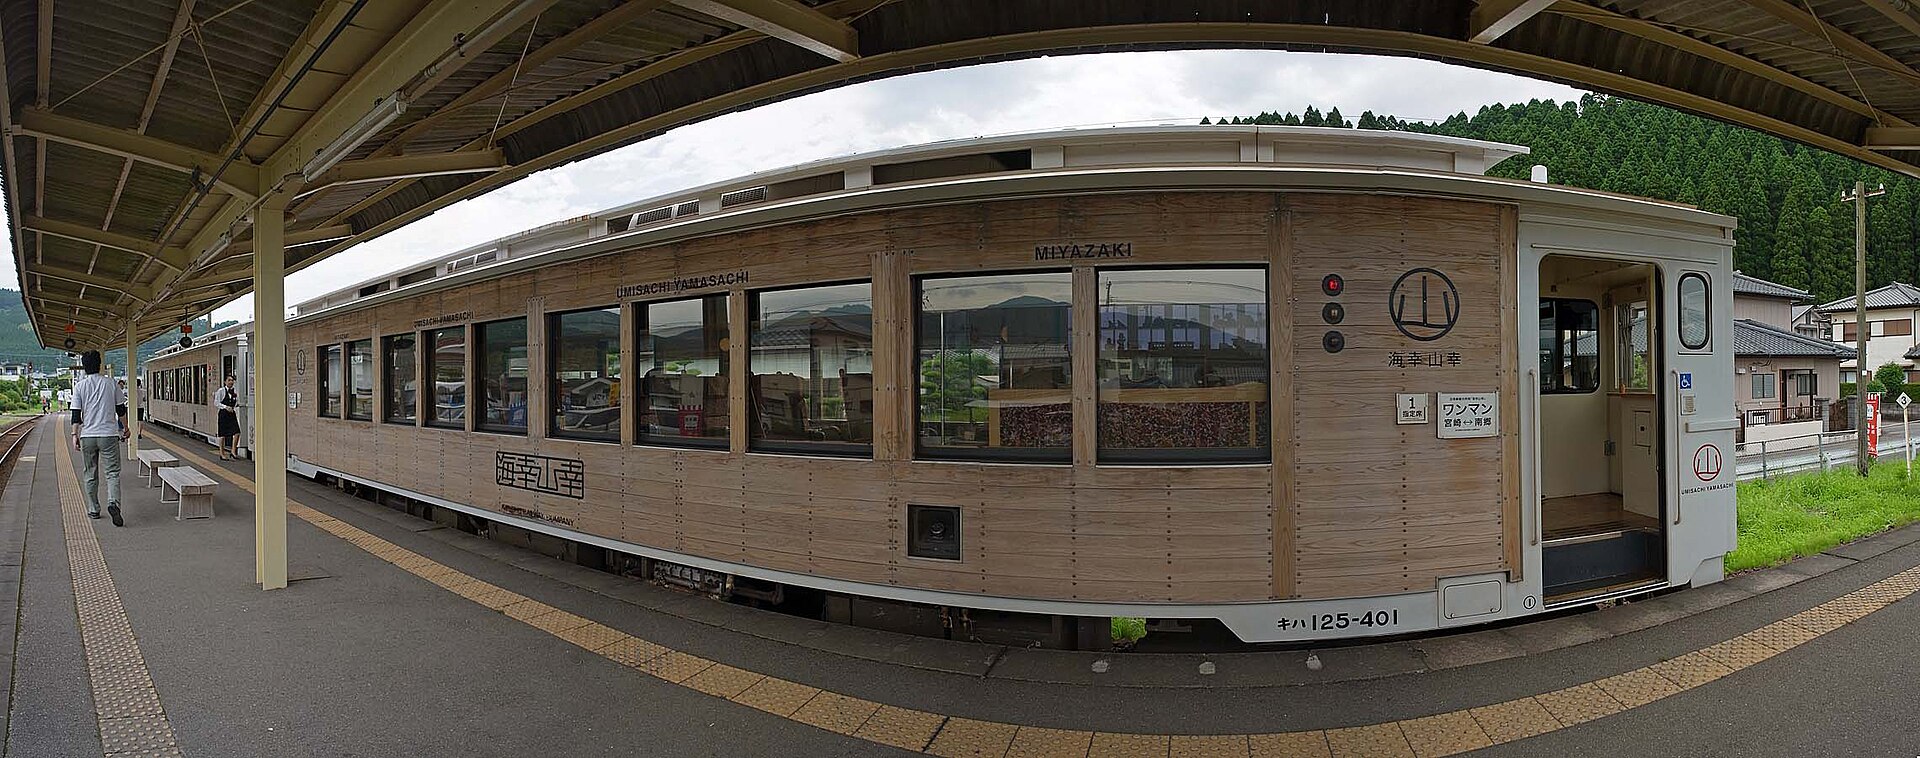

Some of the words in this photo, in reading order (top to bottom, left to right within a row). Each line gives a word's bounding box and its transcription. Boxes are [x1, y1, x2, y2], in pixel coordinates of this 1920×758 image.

[1035, 242, 1133, 260] MIYAZAKI
[616, 281, 670, 298] UMISACHI
[674, 271, 749, 290] YAMASACHI
[1388, 351, 1462, 367] 海幸山幸
[1408, 397, 1416, 409] 1
[1443, 403, 1493, 416] ワンマン
[1402, 410, 1423, 418] 指定席
[1444, 418, 1461, 428] 宮崎
[1474, 417, 1492, 427] 南郷
